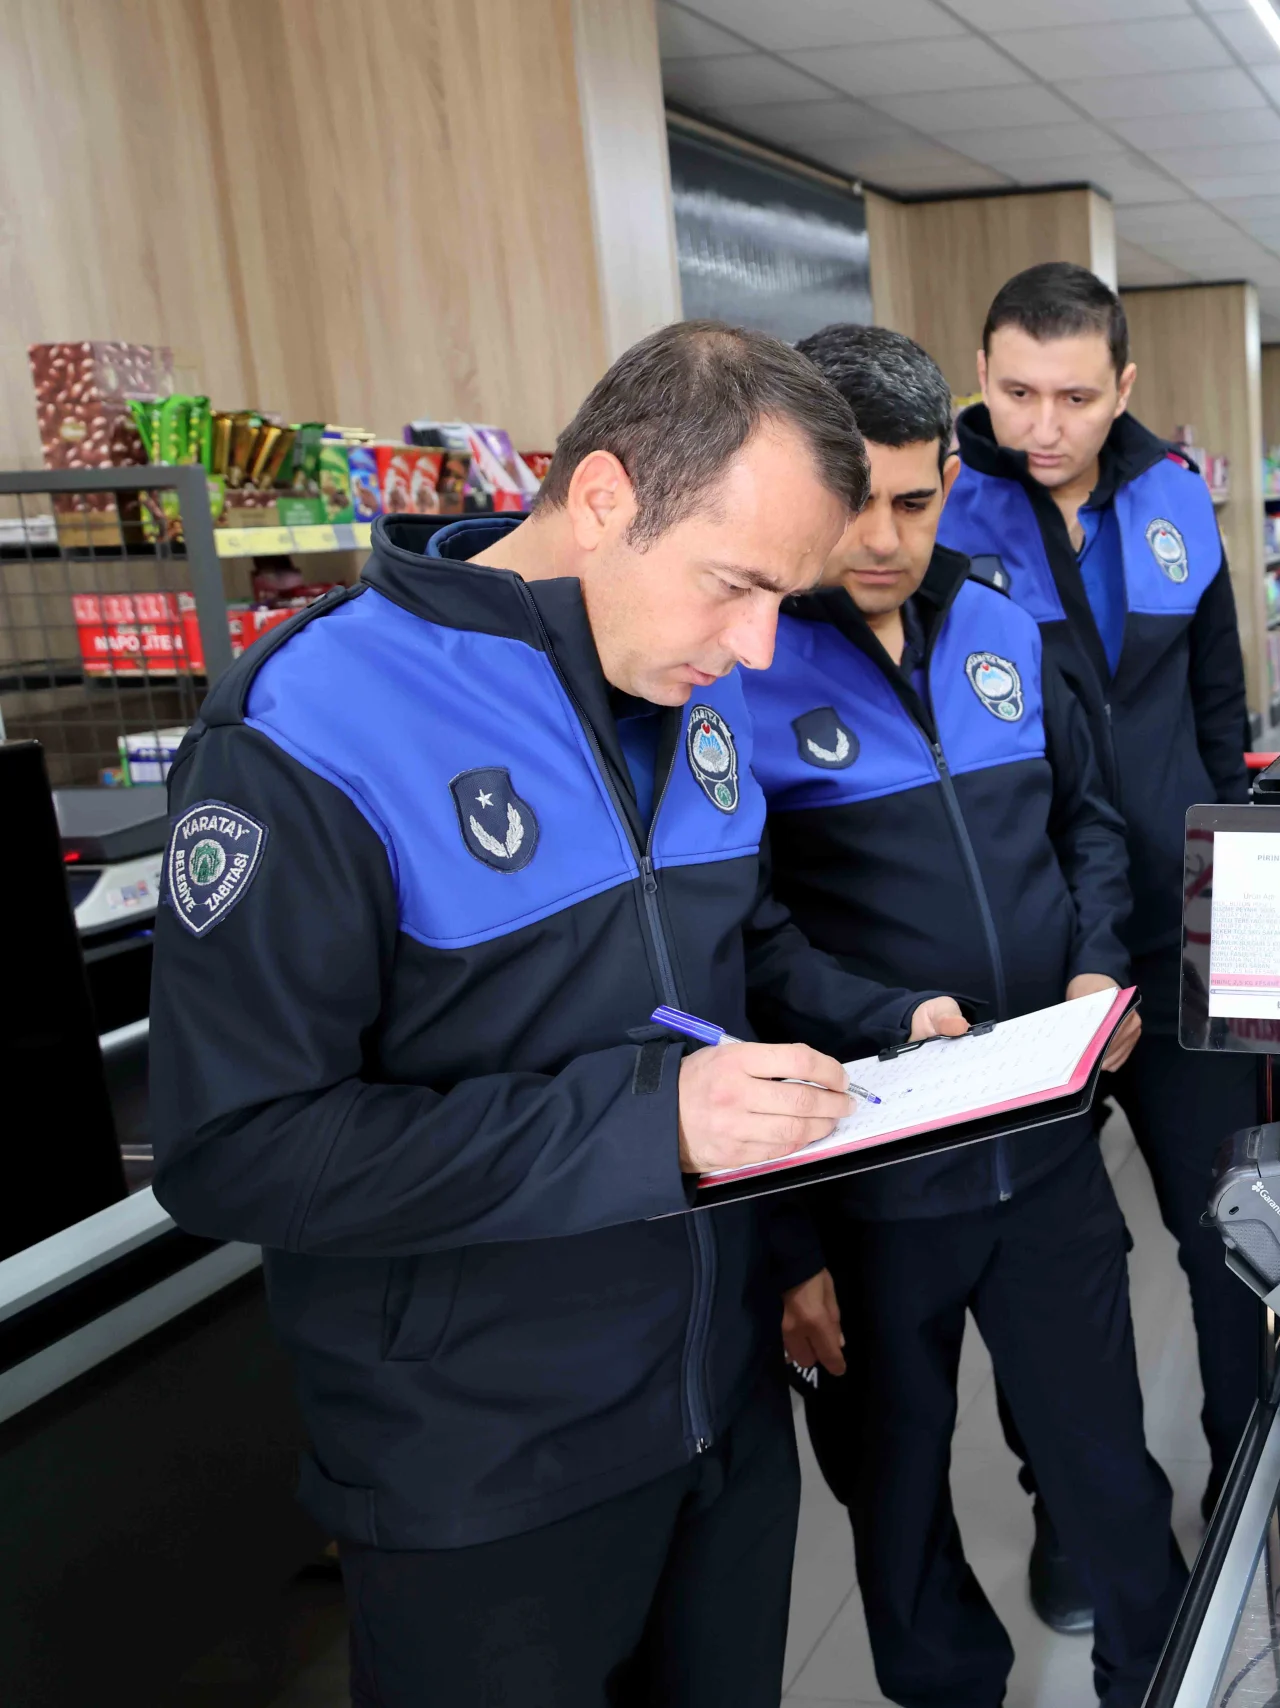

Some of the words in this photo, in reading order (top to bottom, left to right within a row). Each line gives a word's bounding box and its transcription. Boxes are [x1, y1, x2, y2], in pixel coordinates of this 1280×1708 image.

[182, 815, 250, 841] KARATAY
[175, 849, 197, 913] BELEDİYE
[204, 852, 250, 912] ZABITASI
